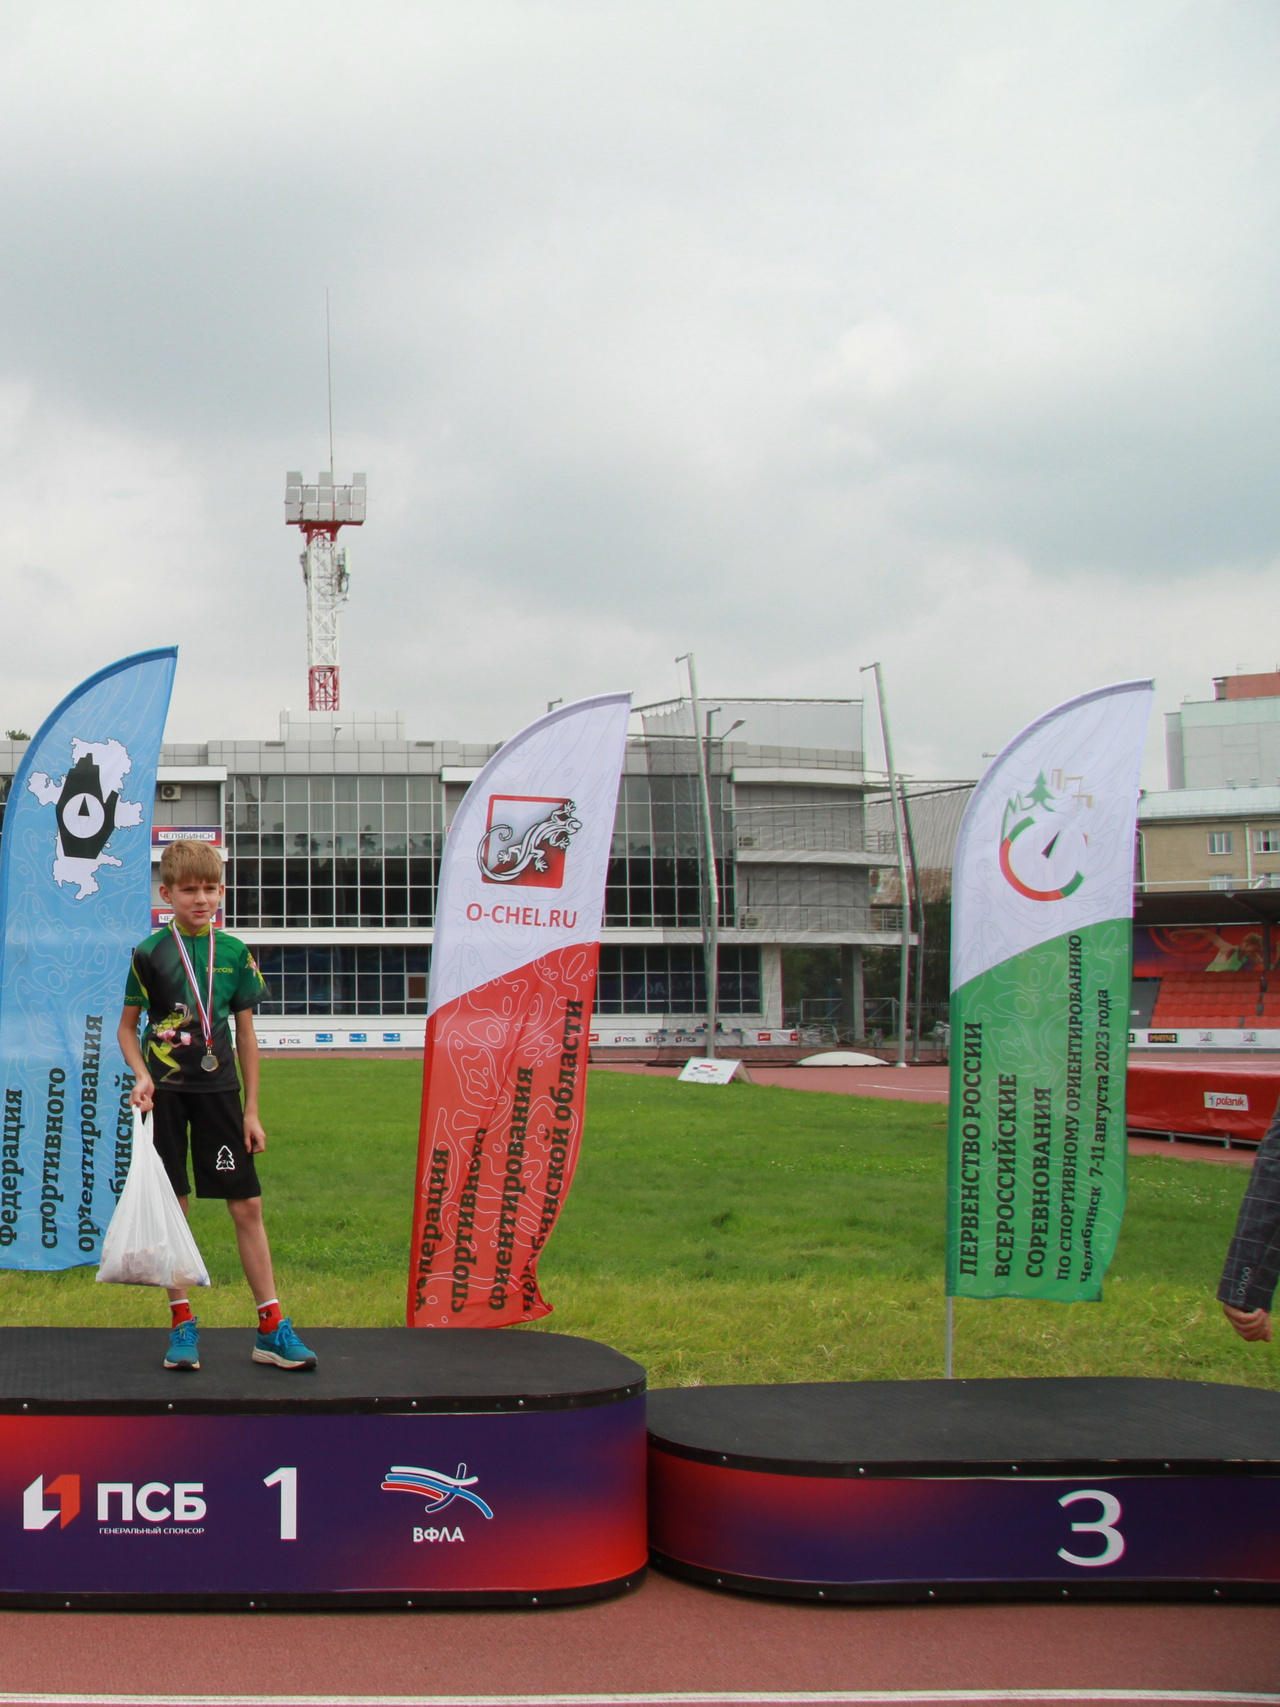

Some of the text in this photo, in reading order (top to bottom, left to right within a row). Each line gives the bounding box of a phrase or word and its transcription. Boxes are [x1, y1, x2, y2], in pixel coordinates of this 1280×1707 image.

[160, 832, 214, 840] ЧЕЛЯБИНСК
[466, 903, 577, 929] O-CHEL.RU
[548, 998, 584, 1122] области
[1056, 934, 1082, 1281] ПО СПОРТИВНОМУ ОРИЕНТИРОВАНИЮ
[1216, 1096, 1245, 1107] polanik
[40, 1067, 66, 1249] спортивного
[78, 1015, 103, 1252] ориентирования
[109, 1072, 136, 1205] бинской
[960, 1022, 982, 1277] ПЕРВЕНСТВО РОССИИ
[992, 1074, 1017, 1278] ВСЕРОССИЙСКИЕ
[1025, 1087, 1051, 1278] СОРЕВНОВАНИЯ
[1080, 989, 1112, 1283] Челябинск 7-11 августа 2023 года
[97, 1481, 207, 1521] ПСБ
[99, 1526, 205, 1535] ГЕНЕРАЛЬНЫЙ СПОНСОР
[263, 1467, 297, 1540] 1
[413, 1527, 465, 1542] ВФЛА
[1057, 1489, 1125, 1567] 3
